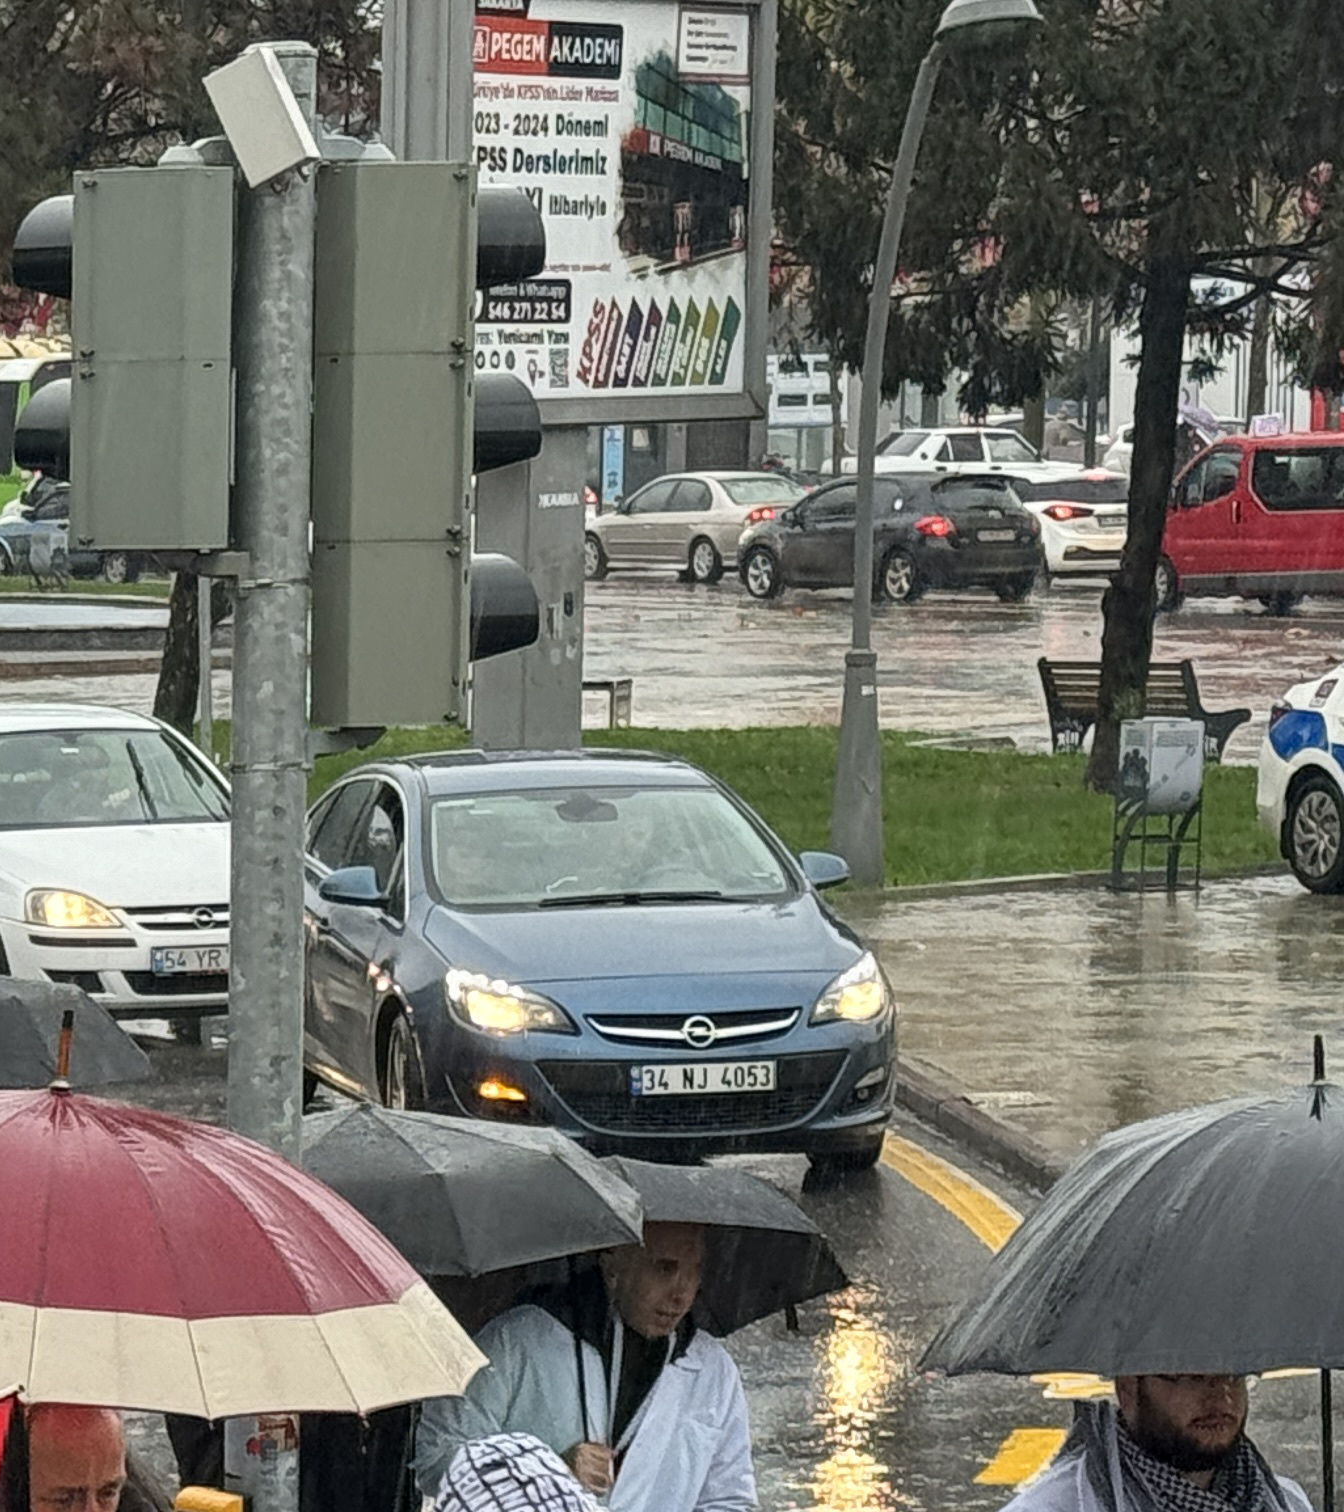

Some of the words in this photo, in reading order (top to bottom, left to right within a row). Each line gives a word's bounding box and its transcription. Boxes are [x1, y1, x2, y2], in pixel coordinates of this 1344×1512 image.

[490, 32, 546, 62] PEGEM
[475, 111, 500, 135] 023
[512, 113, 549, 137] 2024
[555, 112, 609, 137] Dönemi
[477, 145, 508, 173] PSS
[512, 147, 607, 175] Derslerimiz
[165, 951, 186, 968] 54
[195, 949, 221, 968] YR
[644, 1069, 669, 1091] 34
[682, 1067, 708, 1090] NJ
[721, 1065, 771, 1088] 4053
